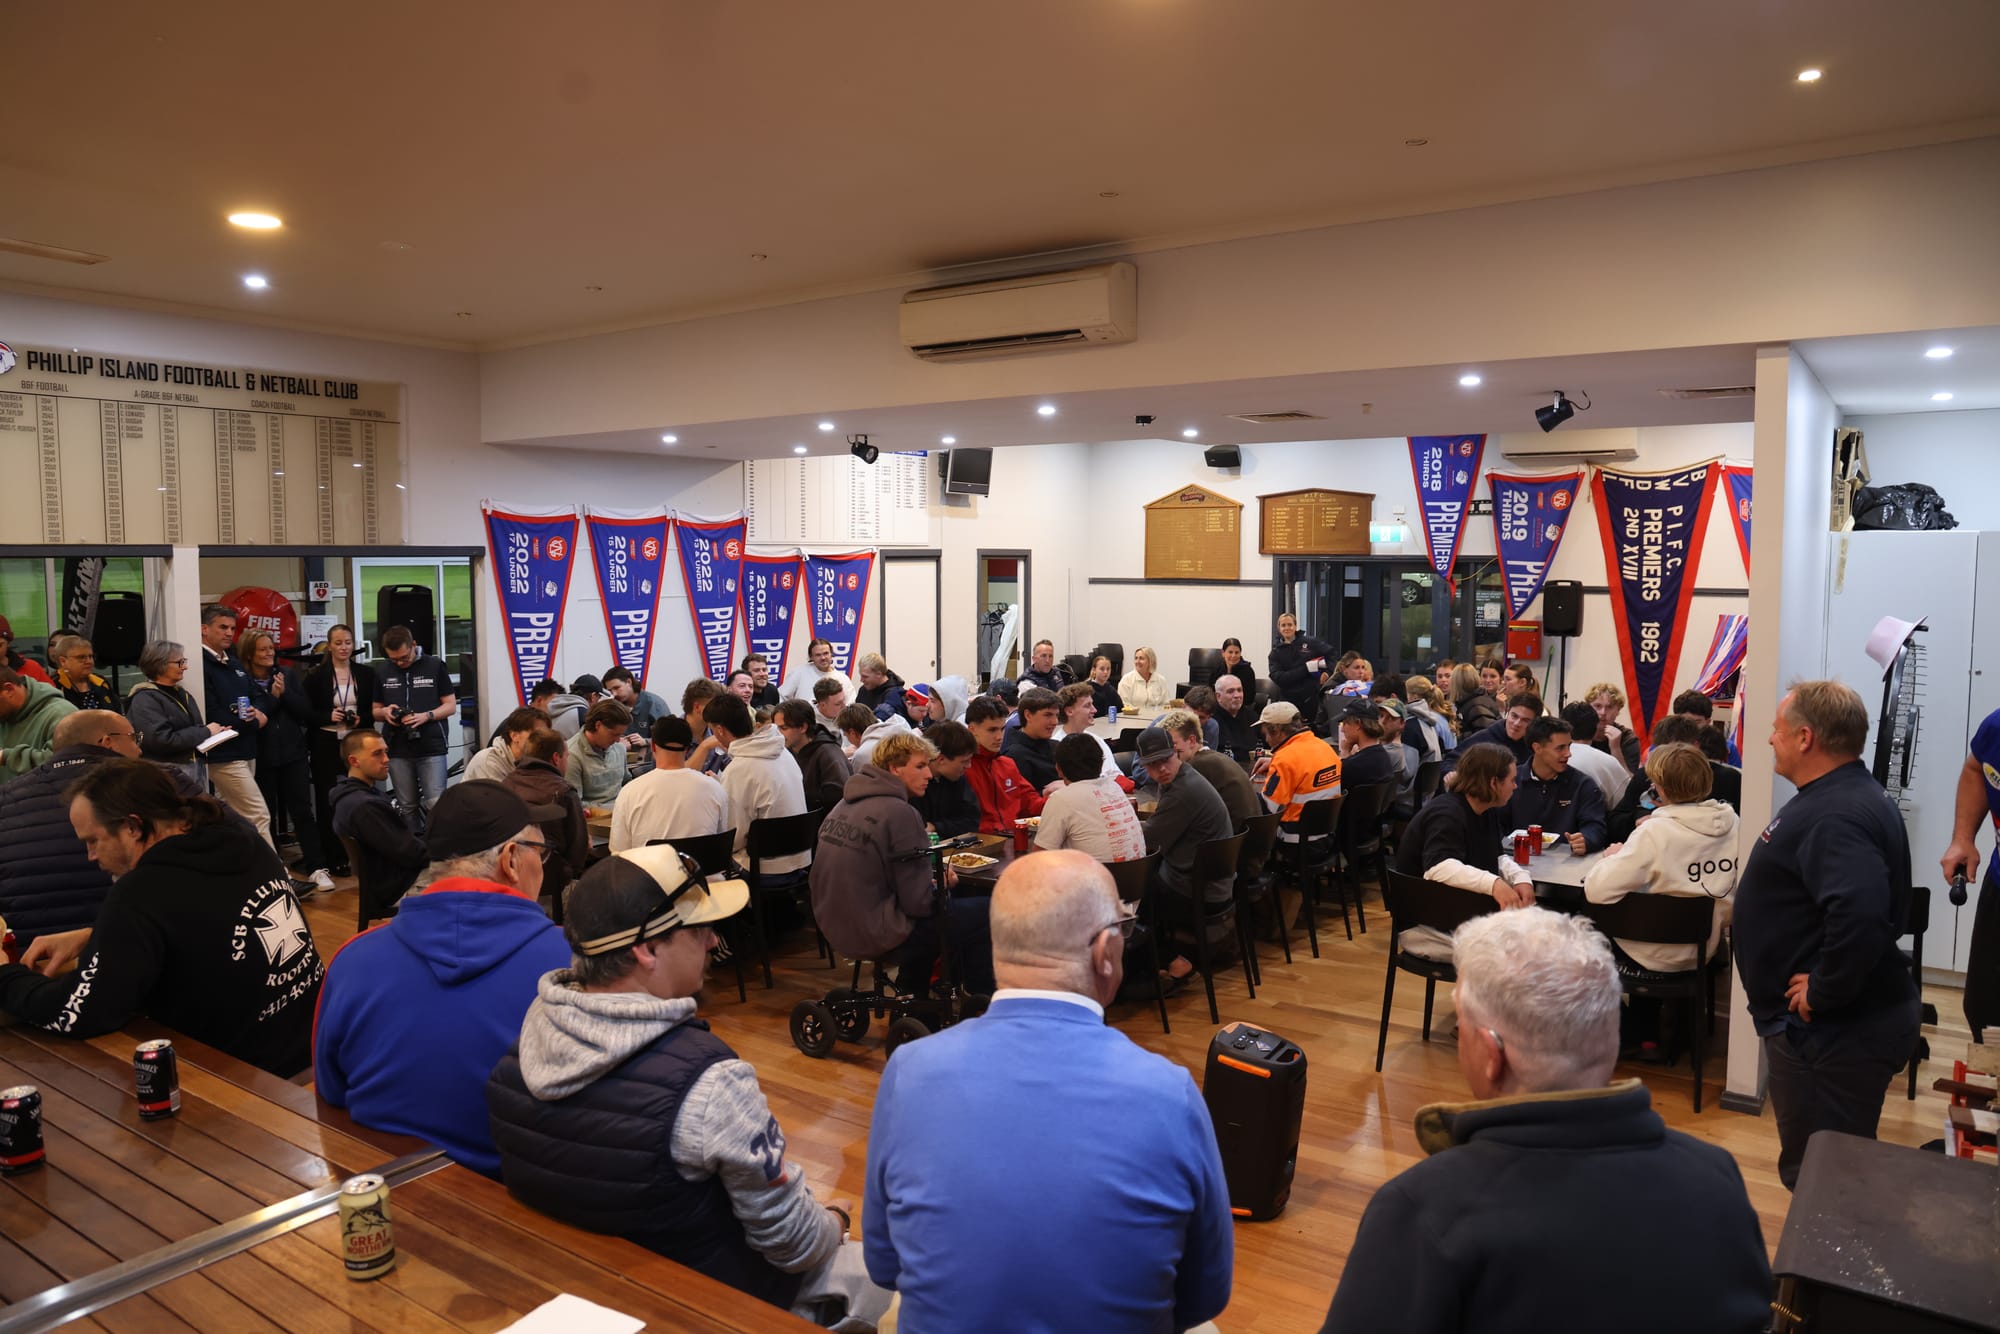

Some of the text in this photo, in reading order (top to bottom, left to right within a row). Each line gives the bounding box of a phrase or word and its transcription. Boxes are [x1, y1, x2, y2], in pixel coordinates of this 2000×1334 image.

[27, 351, 359, 400] PHILLIP ISLAND FOOTBALL & NETBALL CLUB
[36, 382, 69, 393] FOOTBALL
[1422, 450, 1430, 488] THIRDS
[1431, 447, 1443, 491] 2018
[1425, 501, 1462, 571] PREMIERS
[1501, 490, 1513, 541] THIRDS
[1512, 491, 1529, 542] 2019
[1623, 507, 1640, 539] 2ND
[515, 532, 530, 594] 2022
[614, 535, 628, 593] 2022
[699, 538, 712, 592] 2022
[1640, 508, 1663, 663] PREMIERS 1962
[757, 575, 767, 627] 2018
[823, 568, 835, 625] 2024
[248, 615, 281, 629] FIRE
[232, 924, 248, 961] SCB
[258, 994, 288, 1022] 0412
[290, 973, 312, 1001] 404
[350, 1228, 388, 1248] GREAT
